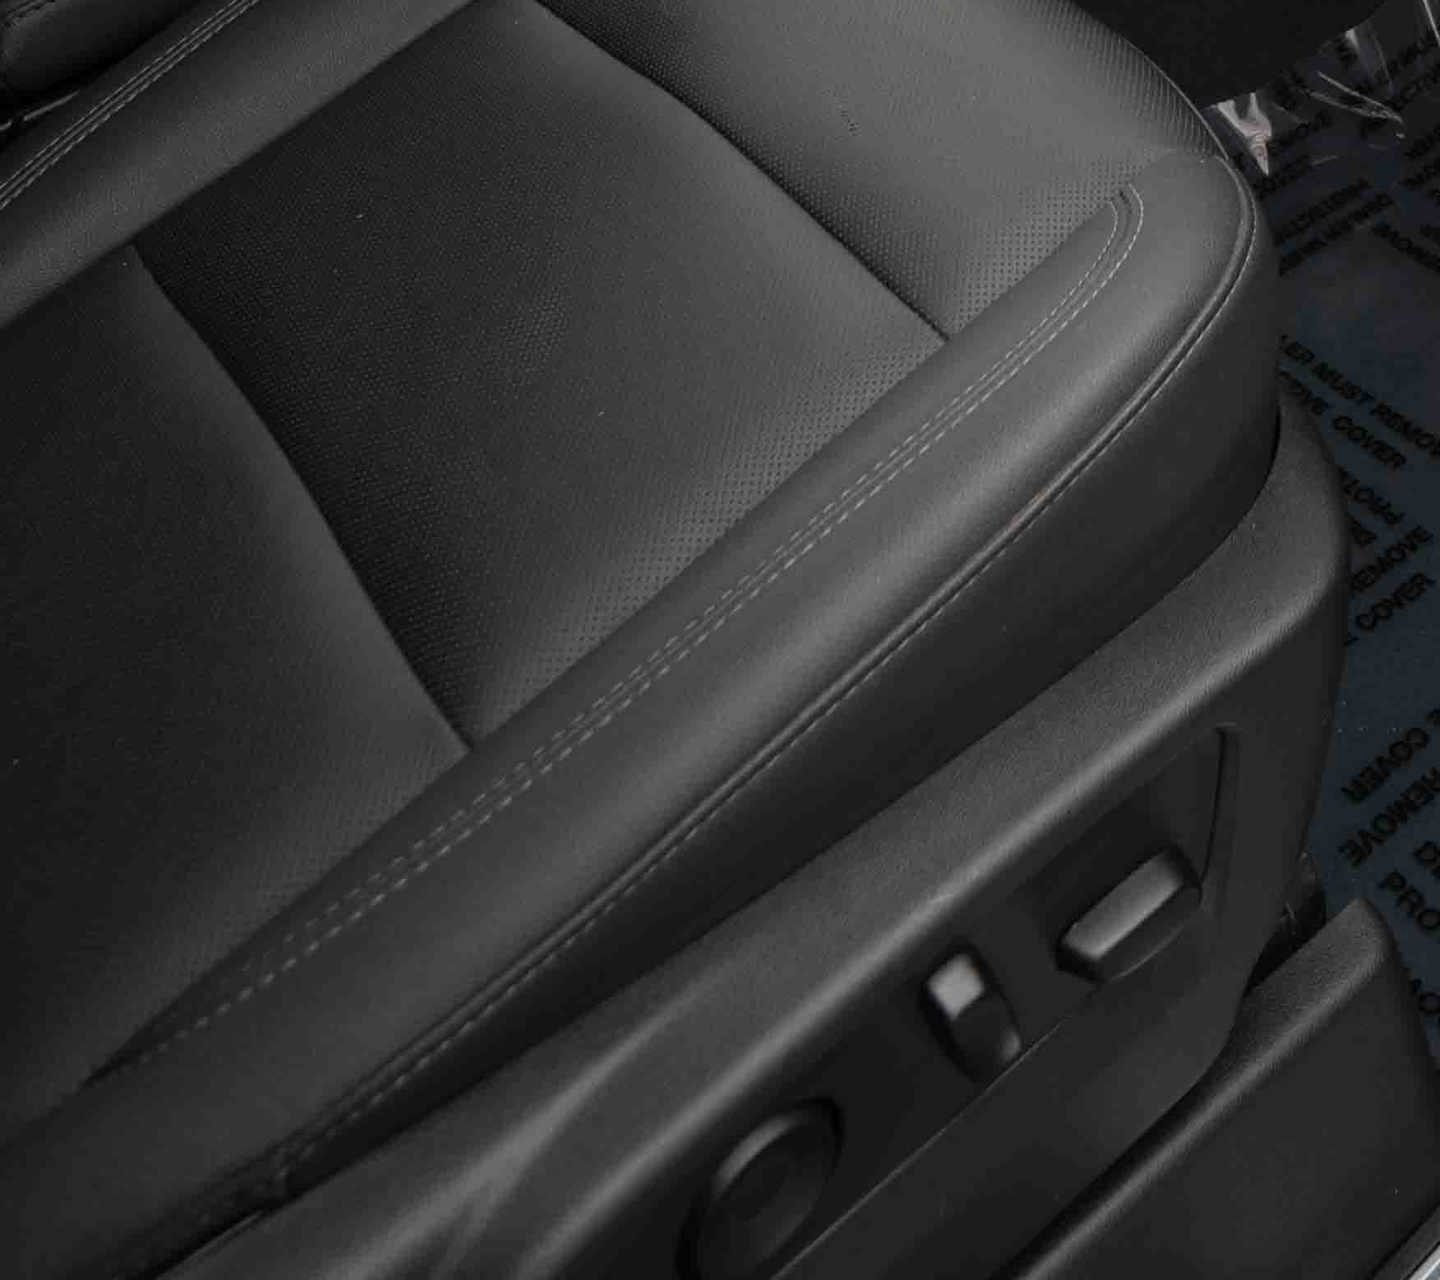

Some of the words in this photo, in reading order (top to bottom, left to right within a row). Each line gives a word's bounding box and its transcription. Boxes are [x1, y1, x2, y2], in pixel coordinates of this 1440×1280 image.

[1332, 415, 1407, 471] COVER
[1355, 571, 1437, 634] COVER
[1341, 726, 1430, 805] COVER
